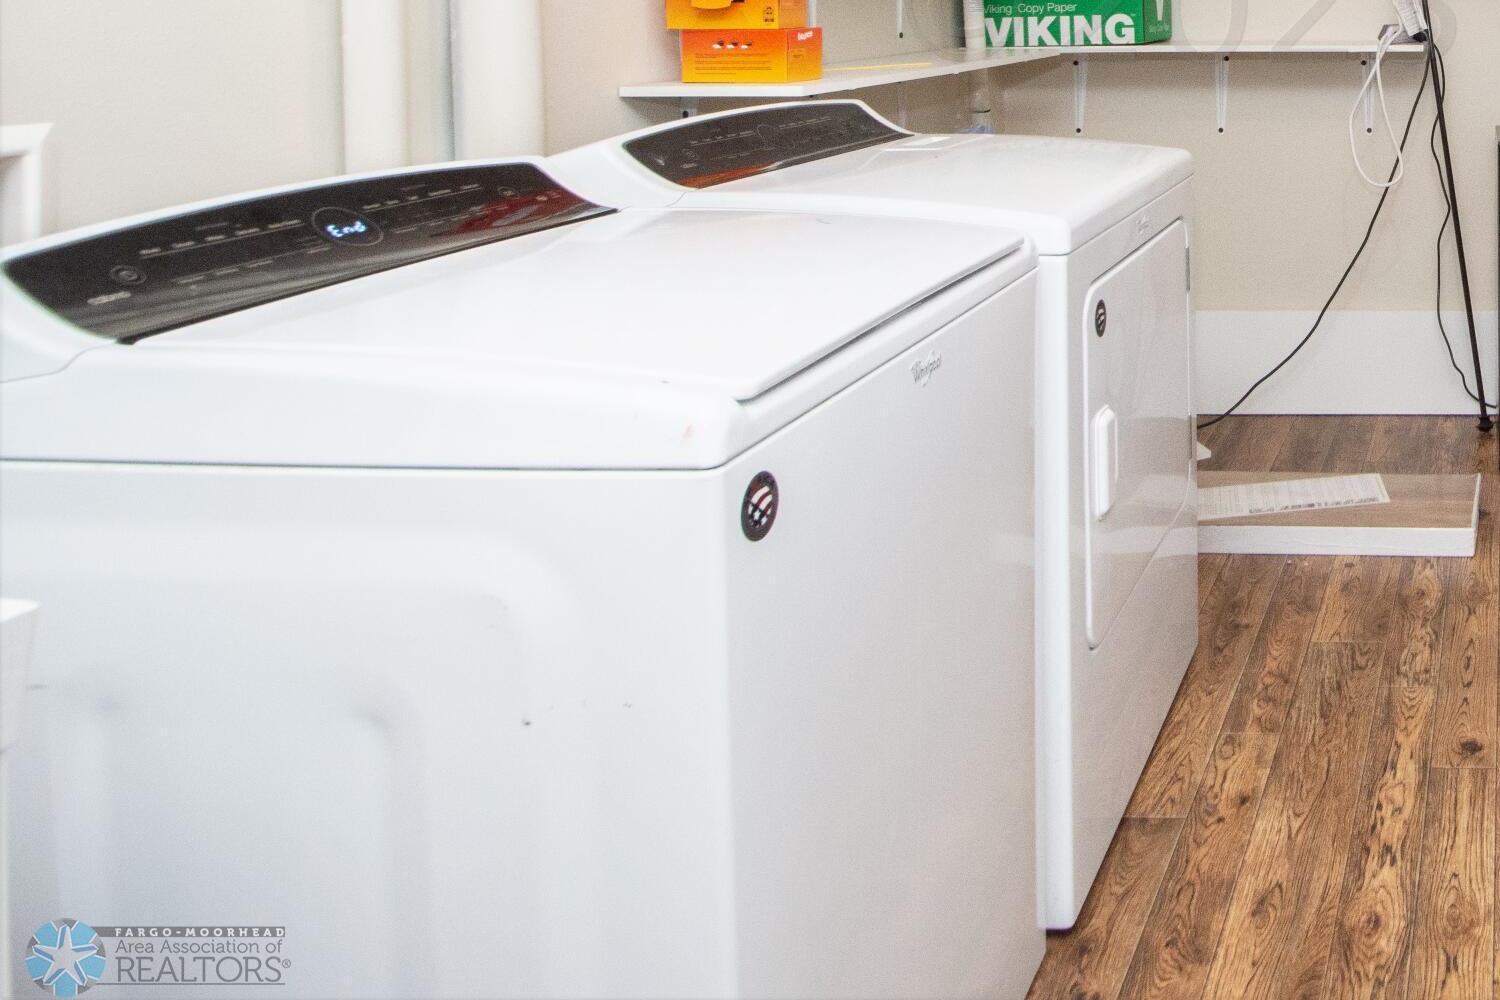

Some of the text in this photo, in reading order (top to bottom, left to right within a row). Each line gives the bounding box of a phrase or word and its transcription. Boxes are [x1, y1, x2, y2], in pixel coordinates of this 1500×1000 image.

[1017, 3, 1045, 14] Copy
[1046, 2, 1078, 13] Paper
[984, 13, 1136, 47] VIKING
